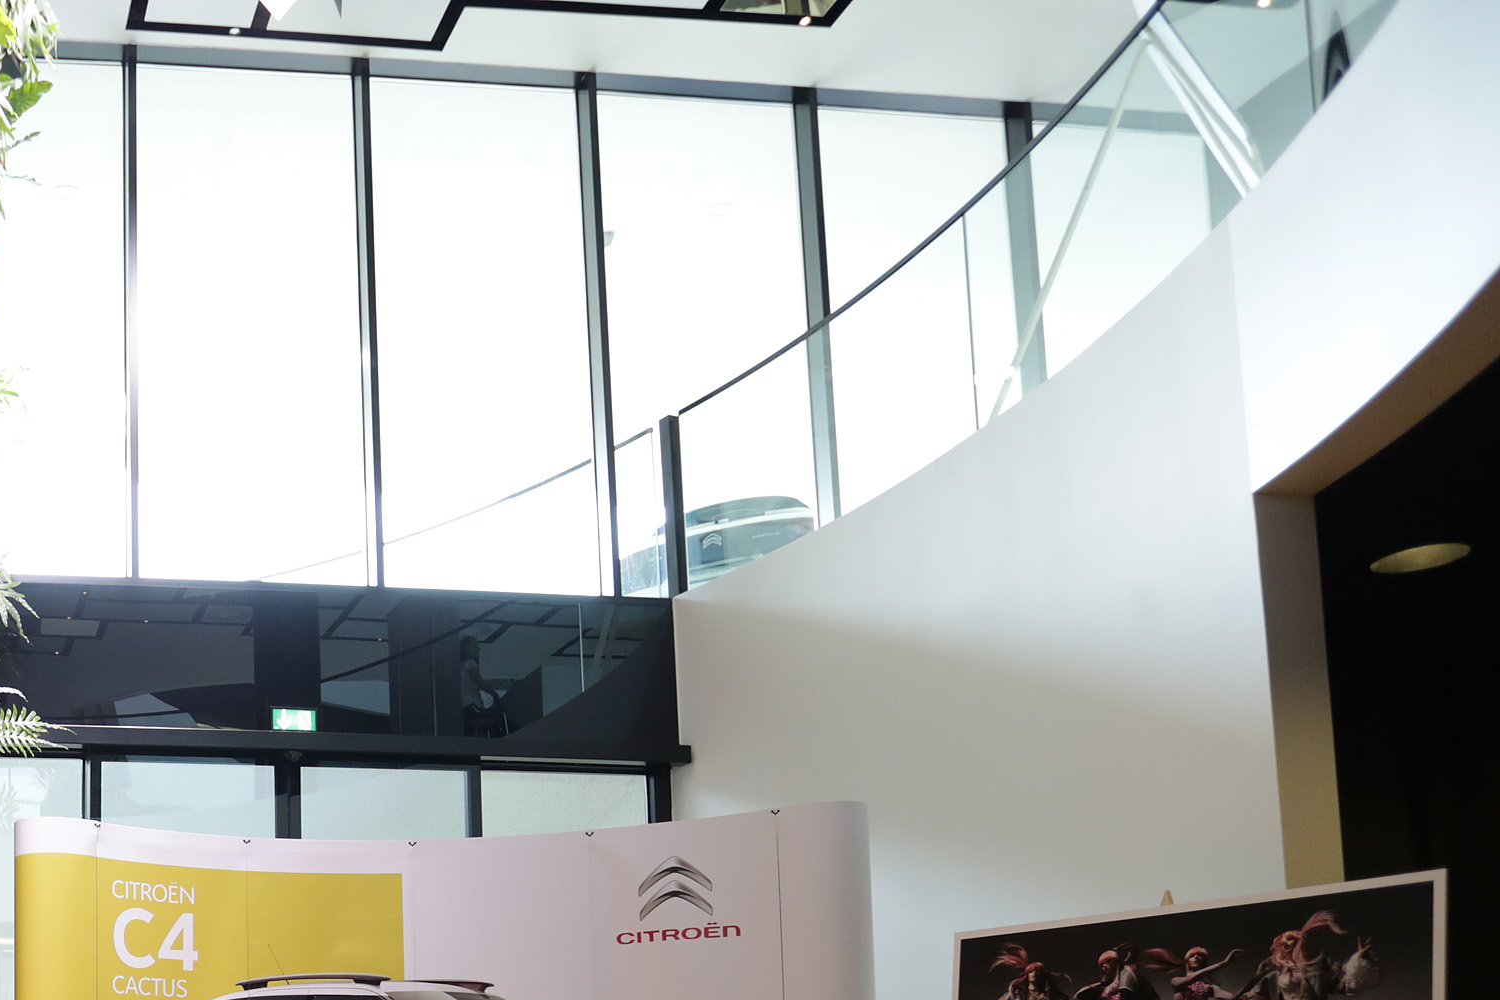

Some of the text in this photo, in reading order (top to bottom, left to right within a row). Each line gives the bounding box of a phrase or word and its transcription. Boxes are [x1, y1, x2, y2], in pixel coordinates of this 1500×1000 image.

[111, 880, 195, 905] CITROËN
[113, 907, 199, 971] C4
[112, 975, 188, 998] CACTUS
